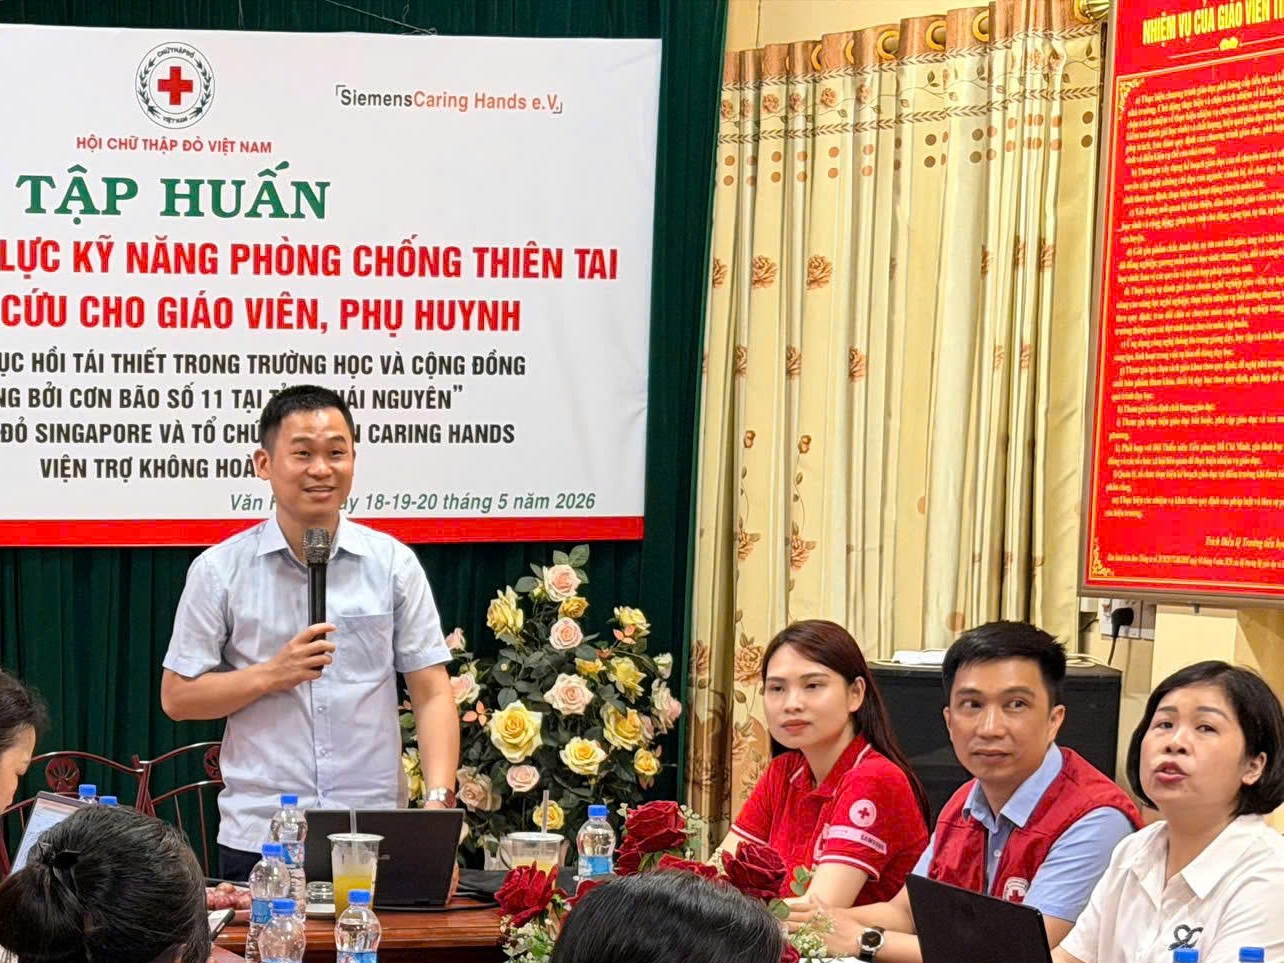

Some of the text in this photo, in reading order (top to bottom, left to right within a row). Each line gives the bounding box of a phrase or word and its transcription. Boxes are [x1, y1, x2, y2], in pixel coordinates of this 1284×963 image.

[474, 93, 527, 109] Hands
[76, 134, 272, 155] HỘI CHỮ THẬP ĐỎ VIỆT NAM
[15, 160, 330, 225] TẬP HUẤN
[0, 237, 60, 279] LỰC
[74, 235, 114, 273] KỸ
[127, 235, 218, 275] NĂNG
[231, 236, 340, 276] PHÒNG
[354, 235, 461, 277] CHỐNG
[473, 241, 563, 279] THIÊN
[574, 249, 617, 279] TAI
[2, 288, 67, 327] CỨU
[80, 296, 144, 328] CHO
[158, 290, 233, 329] GIÁO
[245, 292, 327, 334] VIÊN,
[340, 299, 403, 337] PHỤ
[415, 300, 520, 331] HUYNH
[32, 346, 65, 373] HỒI
[73, 349, 103, 373] TÁI
[111, 350, 166, 373] THIẾT
[173, 354, 239, 374] TRONG
[247, 350, 326, 374] TRƯỜNG
[334, 355, 373, 379] HỌC
[380, 351, 404, 374] VÀ
[412, 352, 465, 379] CỘNG
[472, 349, 525, 375] ĐỒNG
[29, 382, 61, 408] BỞI
[70, 387, 111, 408] CƠN
[120, 385, 159, 408] BÃO
[168, 382, 193, 408] SỐ
[202, 390, 221, 408] 11
[232, 389, 261, 413] TẠI
[373, 385, 462, 409] NGUYÊN”
[0, 417, 27, 443] ĐỎ
[36, 424, 152, 443] SINGAPORE
[160, 420, 184, 443] VÀ
[192, 416, 216, 443] TỔ
[223, 419, 261, 443] CHỨ
[369, 424, 441, 443] CARING
[449, 424, 514, 443] HANDS
[40, 454, 258, 482] VIỆN TRỢ KHÔNG HOÀ
[231, 493, 263, 511] Văn
[366, 493, 437, 510] 18-19-20
[443, 492, 492, 514] tháng
[498, 493, 508, 510] 5
[513, 492, 550, 509] năm
[555, 493, 596, 509] 2026
